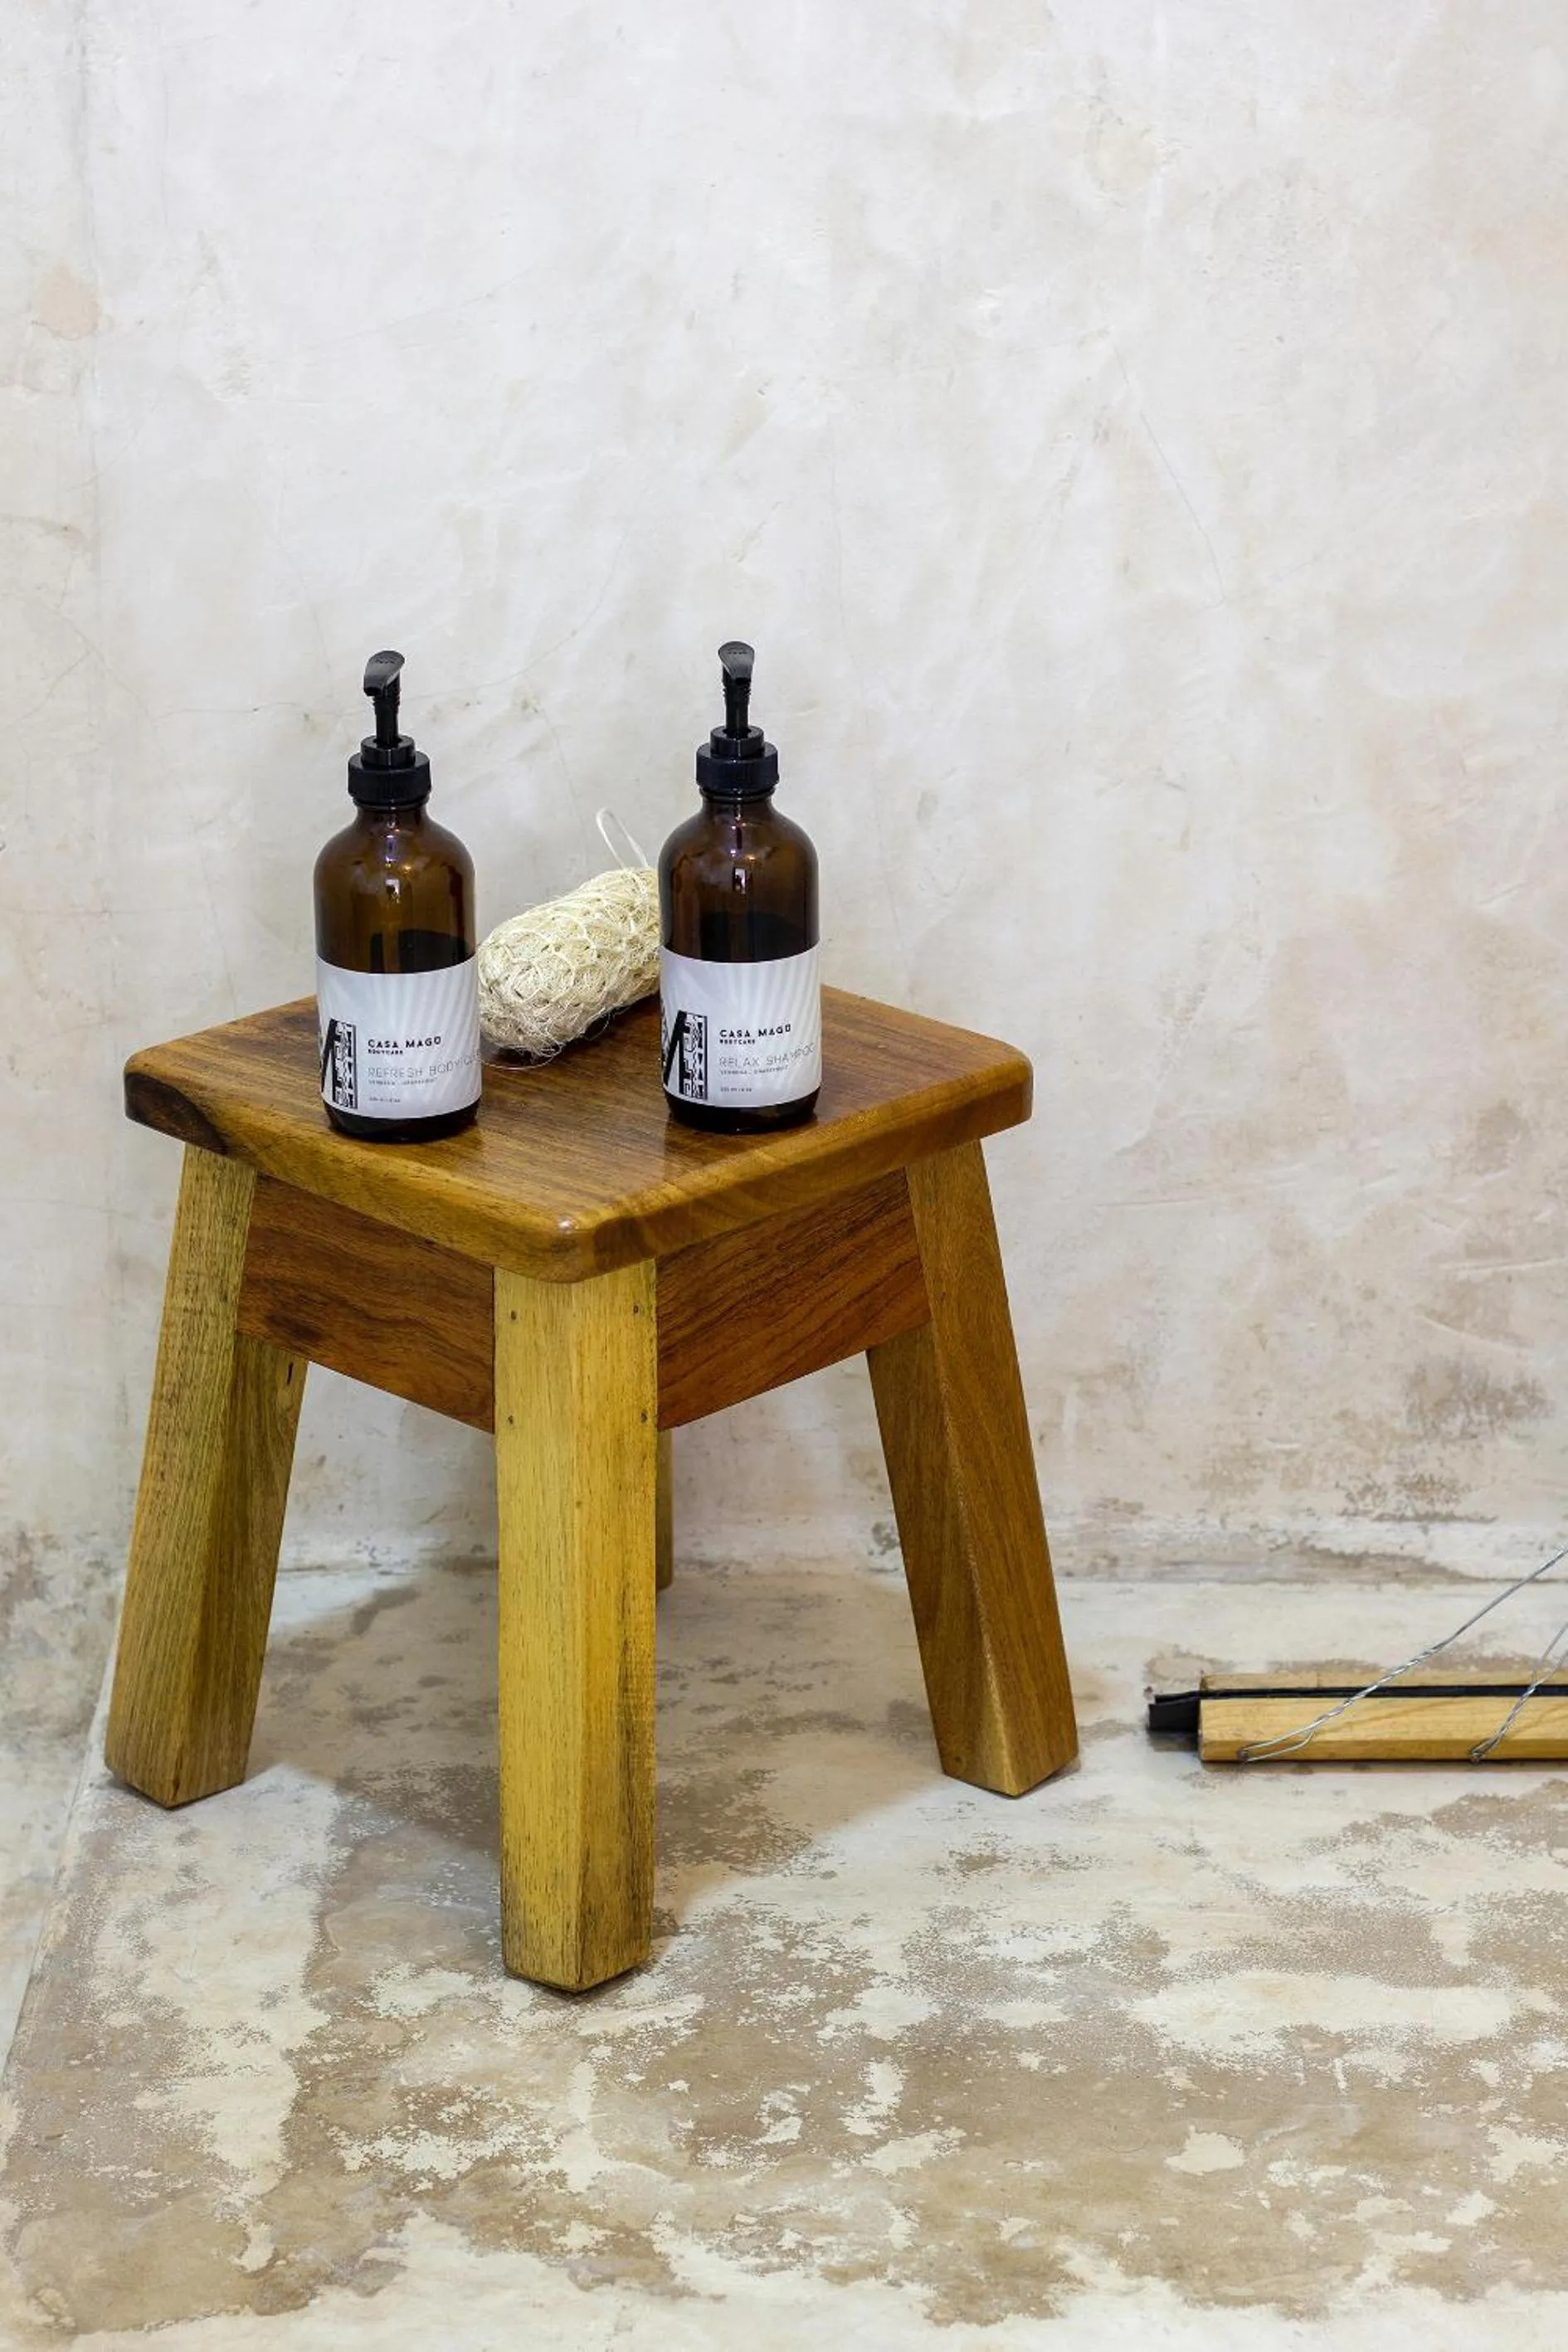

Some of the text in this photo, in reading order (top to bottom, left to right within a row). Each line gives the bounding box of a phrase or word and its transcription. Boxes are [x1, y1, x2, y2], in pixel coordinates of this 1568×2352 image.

[719, 1023, 791, 1038] CASA MAGO
[368, 1035, 441, 1049] CASA MAGO
[718, 1056, 760, 1067] RELAX
[368, 1067, 423, 1079] REFRESH
